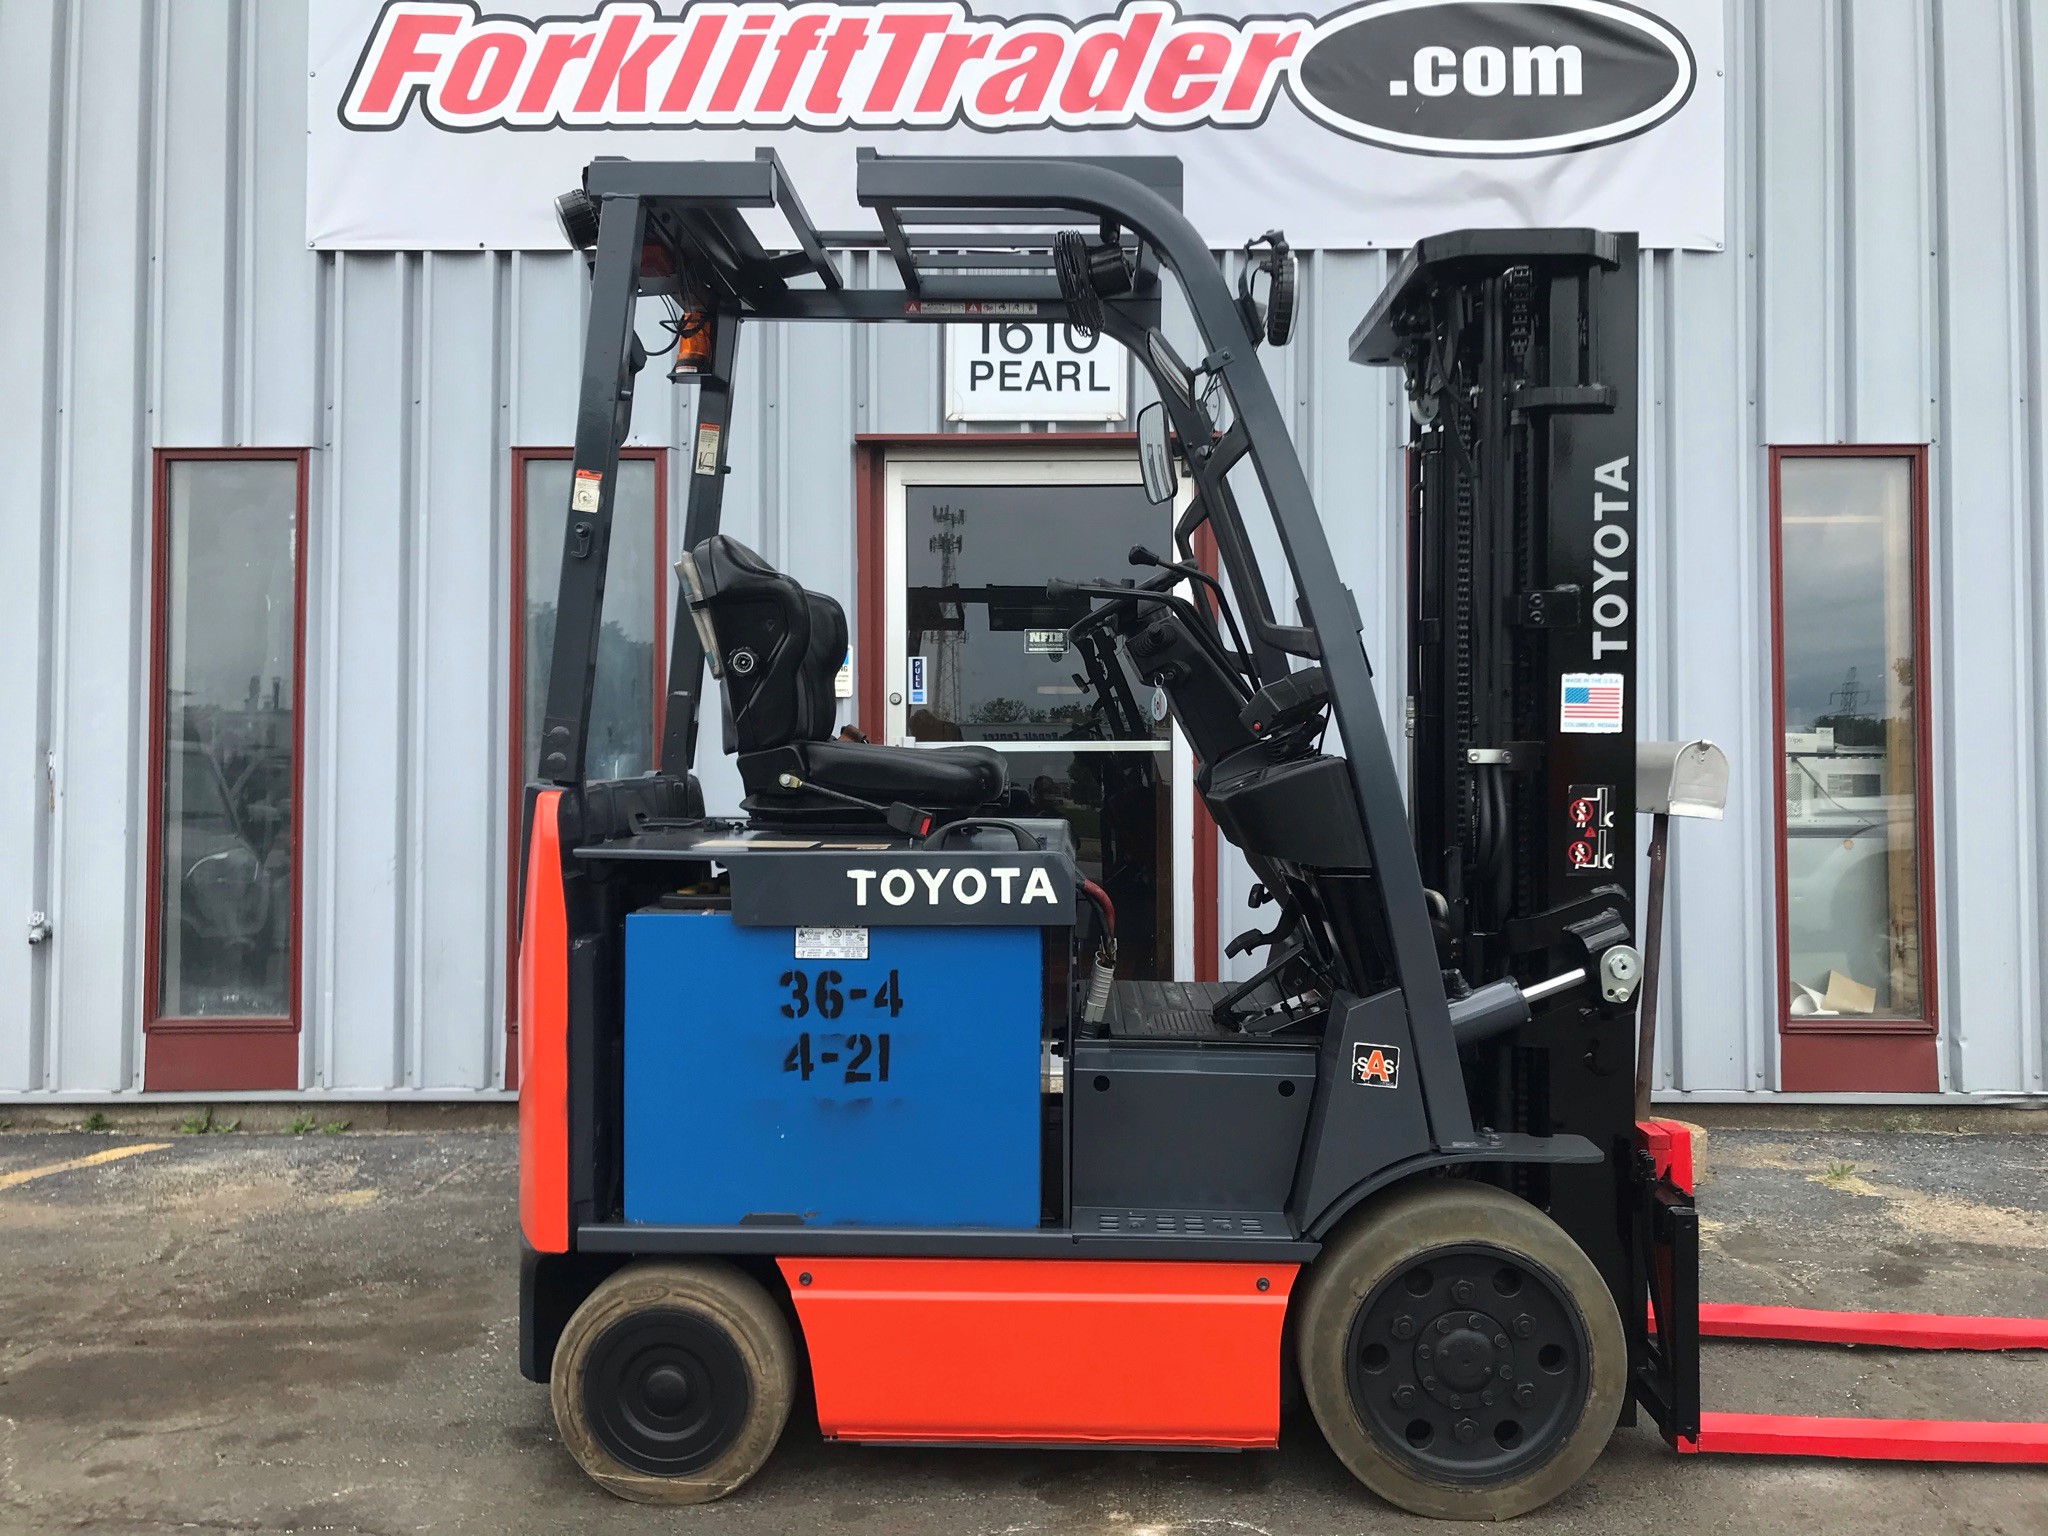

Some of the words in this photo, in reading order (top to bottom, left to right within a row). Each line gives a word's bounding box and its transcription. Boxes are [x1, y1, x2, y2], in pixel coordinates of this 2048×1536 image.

[969, 360, 1111, 392] PEARL
[1591, 455, 1630, 660] TOYOTA
[1029, 631, 1064, 643] NFIB
[846, 867, 1058, 906] TOYOTA
[779, 968, 904, 1020] 36-4
[783, 1031, 891, 1084] 4-21
[1357, 1049, 1395, 1082] SAS
